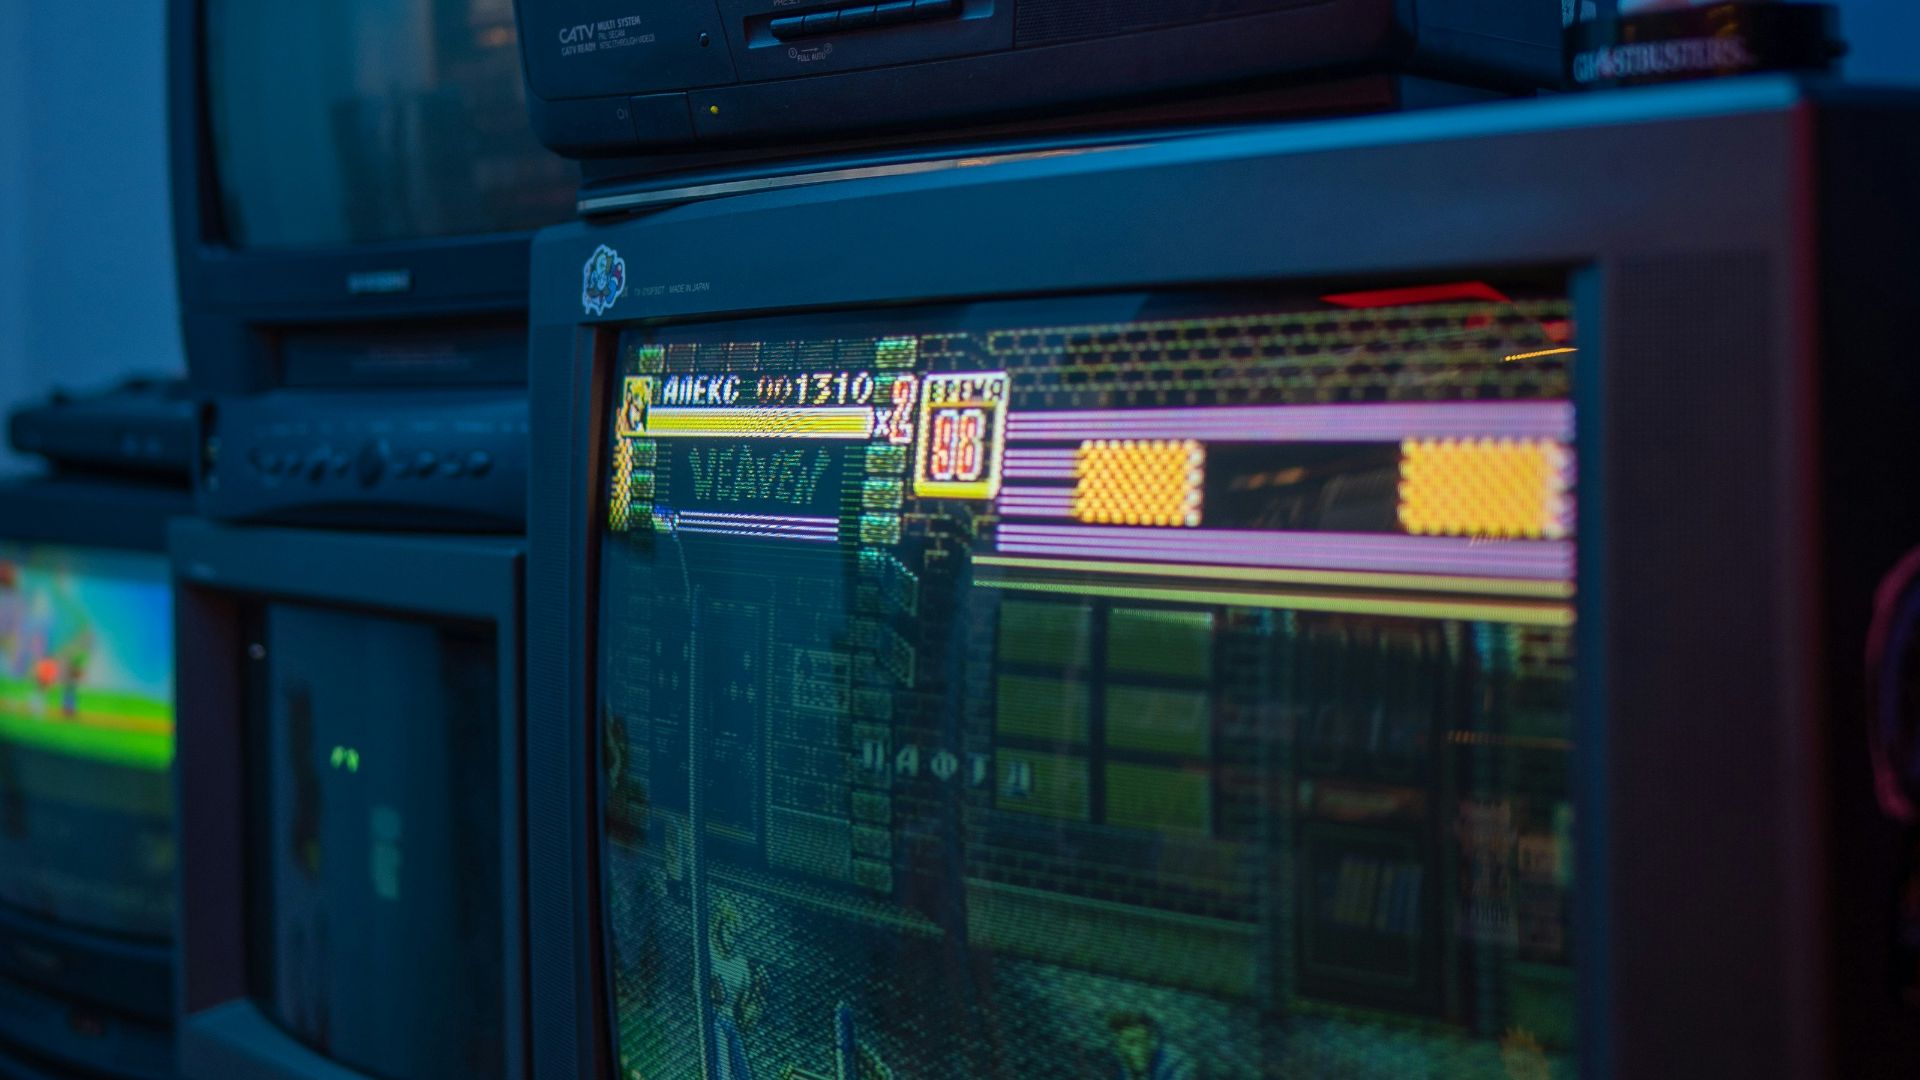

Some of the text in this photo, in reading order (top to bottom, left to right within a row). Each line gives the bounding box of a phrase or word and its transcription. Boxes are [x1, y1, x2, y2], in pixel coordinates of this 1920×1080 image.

[597, 15, 641, 31] MULTI SYSTEM
[559, 23, 595, 44] CATV
[561, 42, 597, 57] CATV READY
[691, 281, 711, 293] JAPAN
